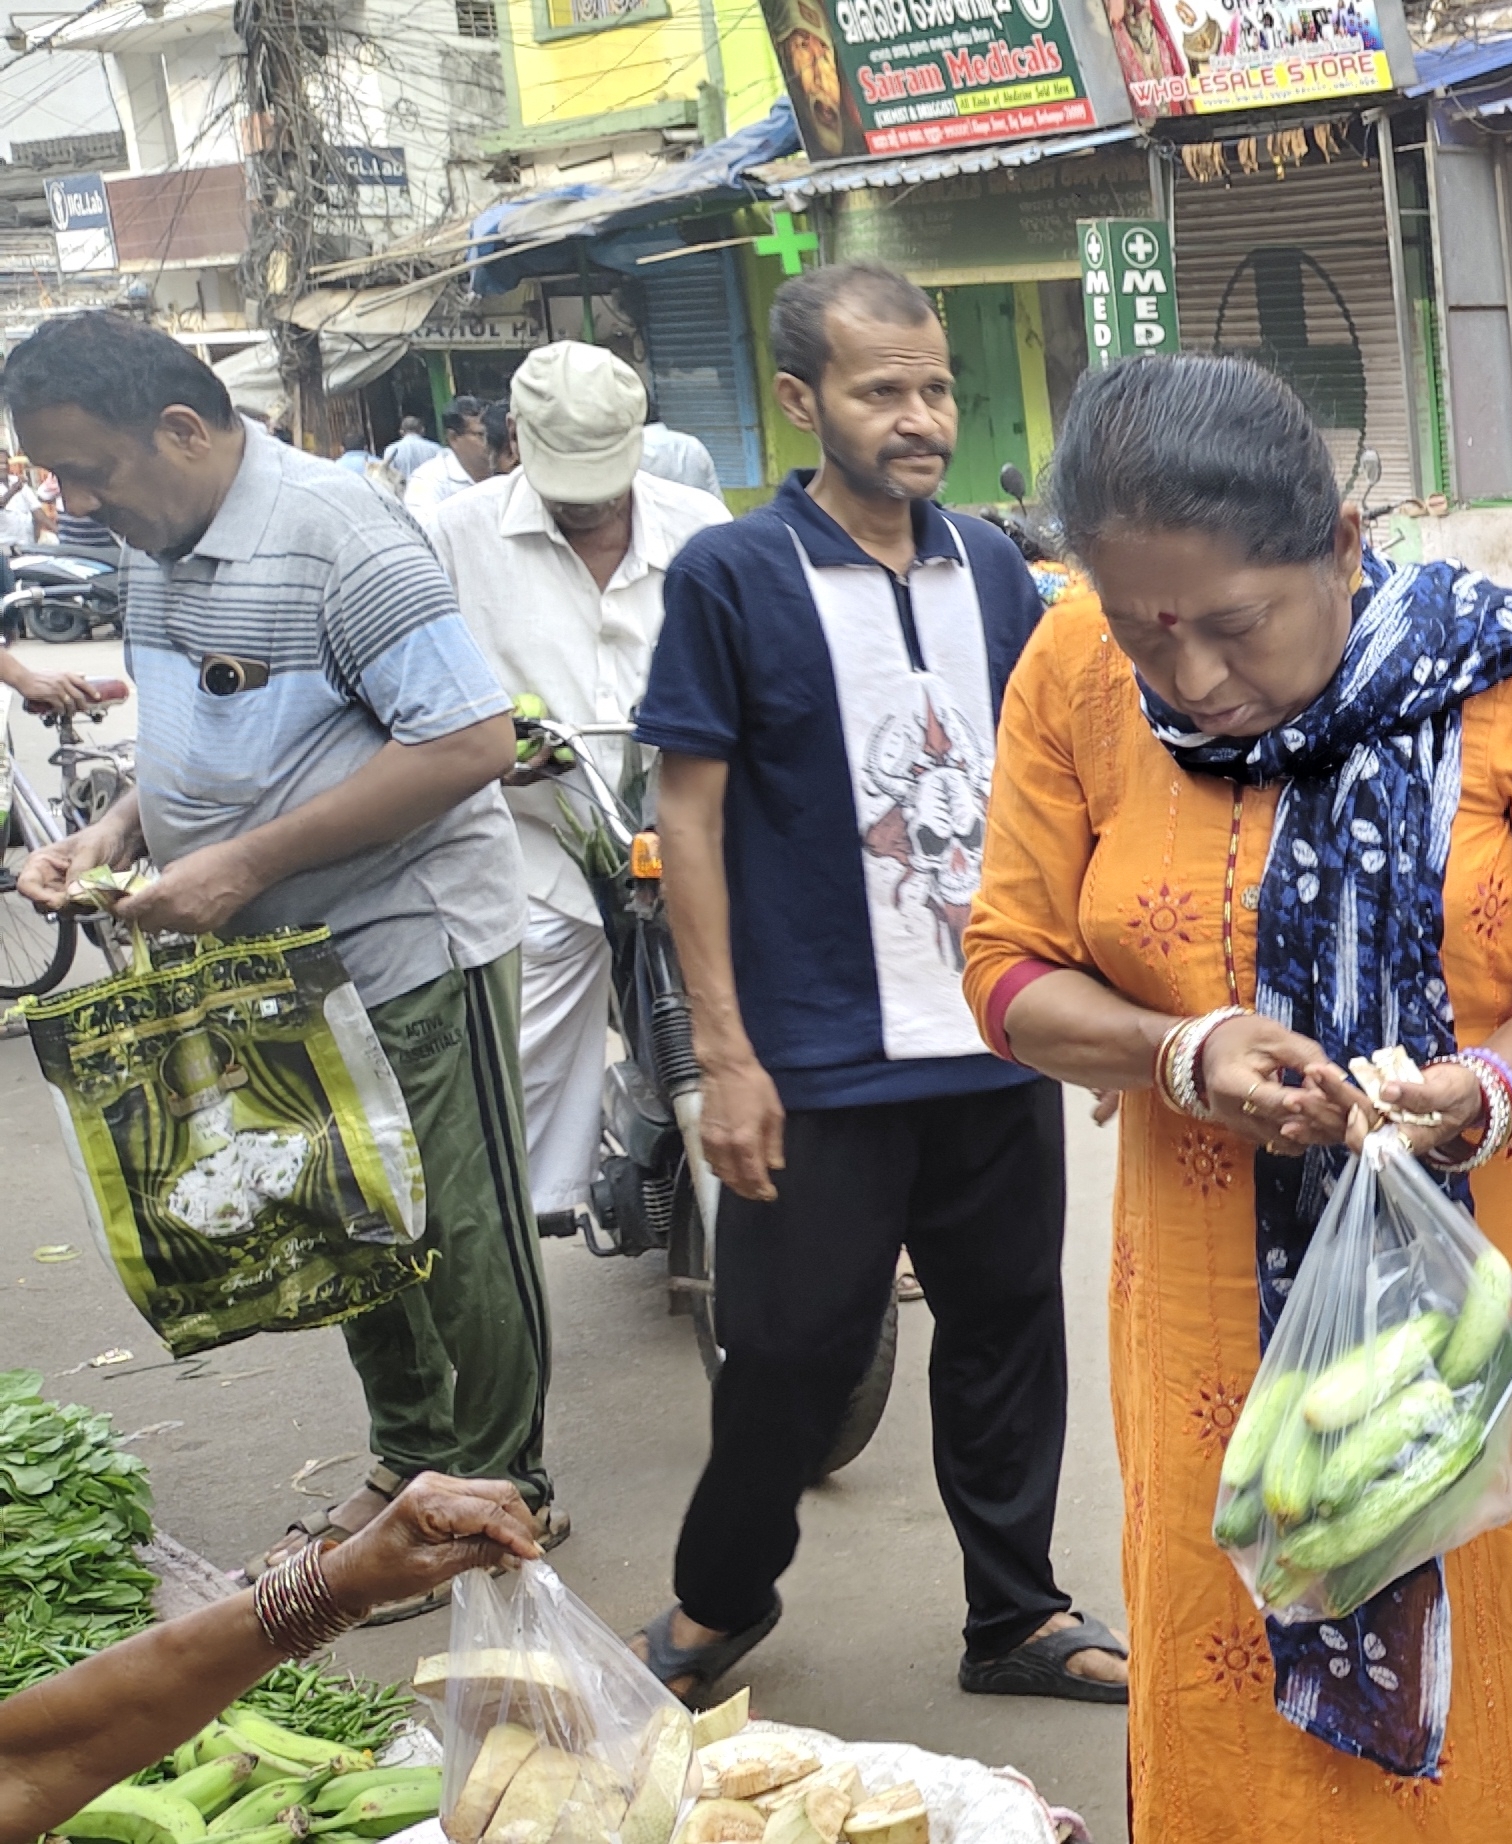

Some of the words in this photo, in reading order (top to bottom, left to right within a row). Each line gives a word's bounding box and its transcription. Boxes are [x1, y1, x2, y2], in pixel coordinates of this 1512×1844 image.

[858, 61, 946, 103] Sairam
[942, 33, 1062, 88] Medicals
[1130, 65, 1275, 106] WHOLESALE
[1286, 53, 1376, 83] STORE
[1121, 269, 1167, 356] MED
[405, 1014, 454, 1039] ACTIV
